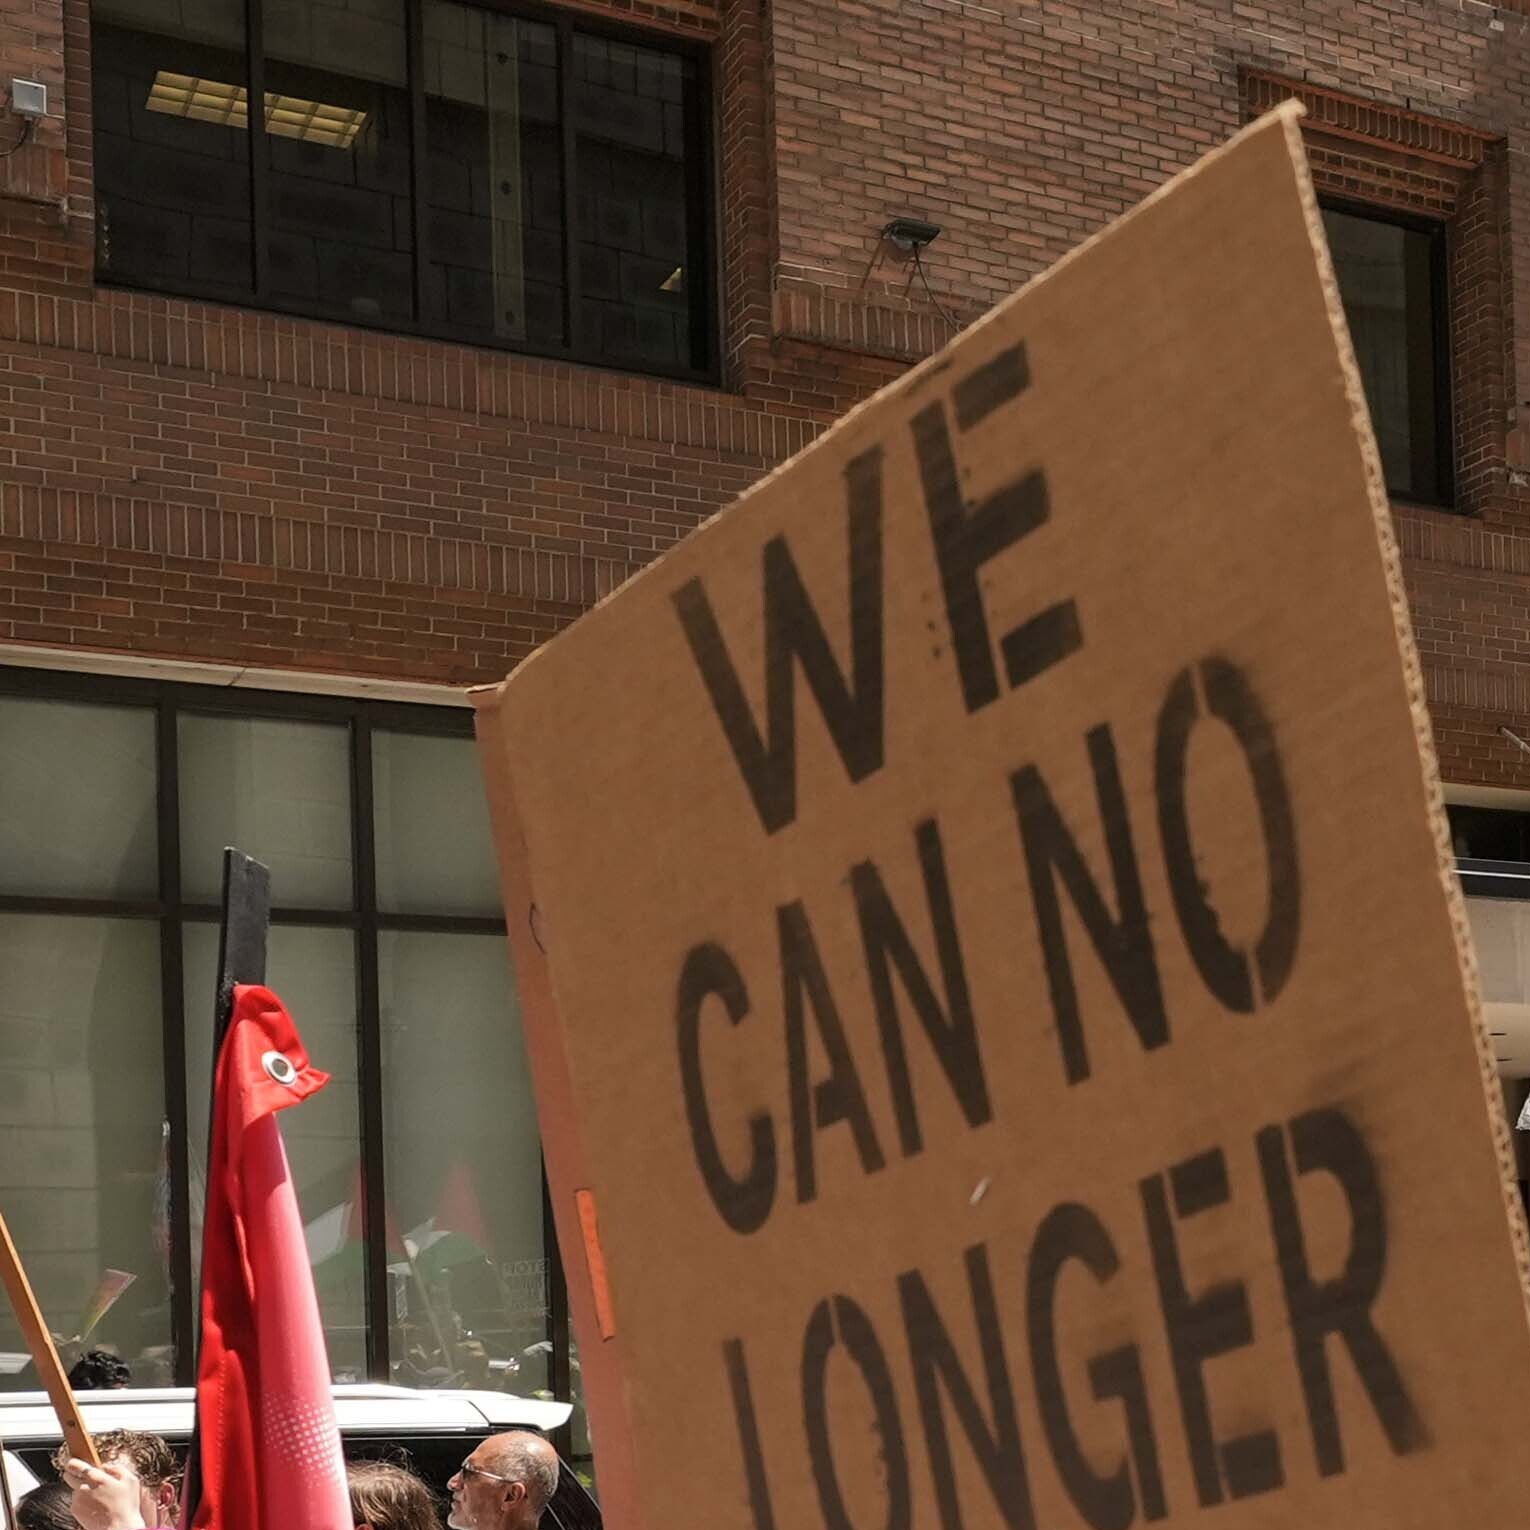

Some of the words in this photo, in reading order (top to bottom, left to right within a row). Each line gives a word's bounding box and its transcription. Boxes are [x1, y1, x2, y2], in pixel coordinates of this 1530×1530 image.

[672, 343, 1083, 836] WE
[676, 816, 993, 1236] CAN
[1010, 655, 1303, 1085] NO
